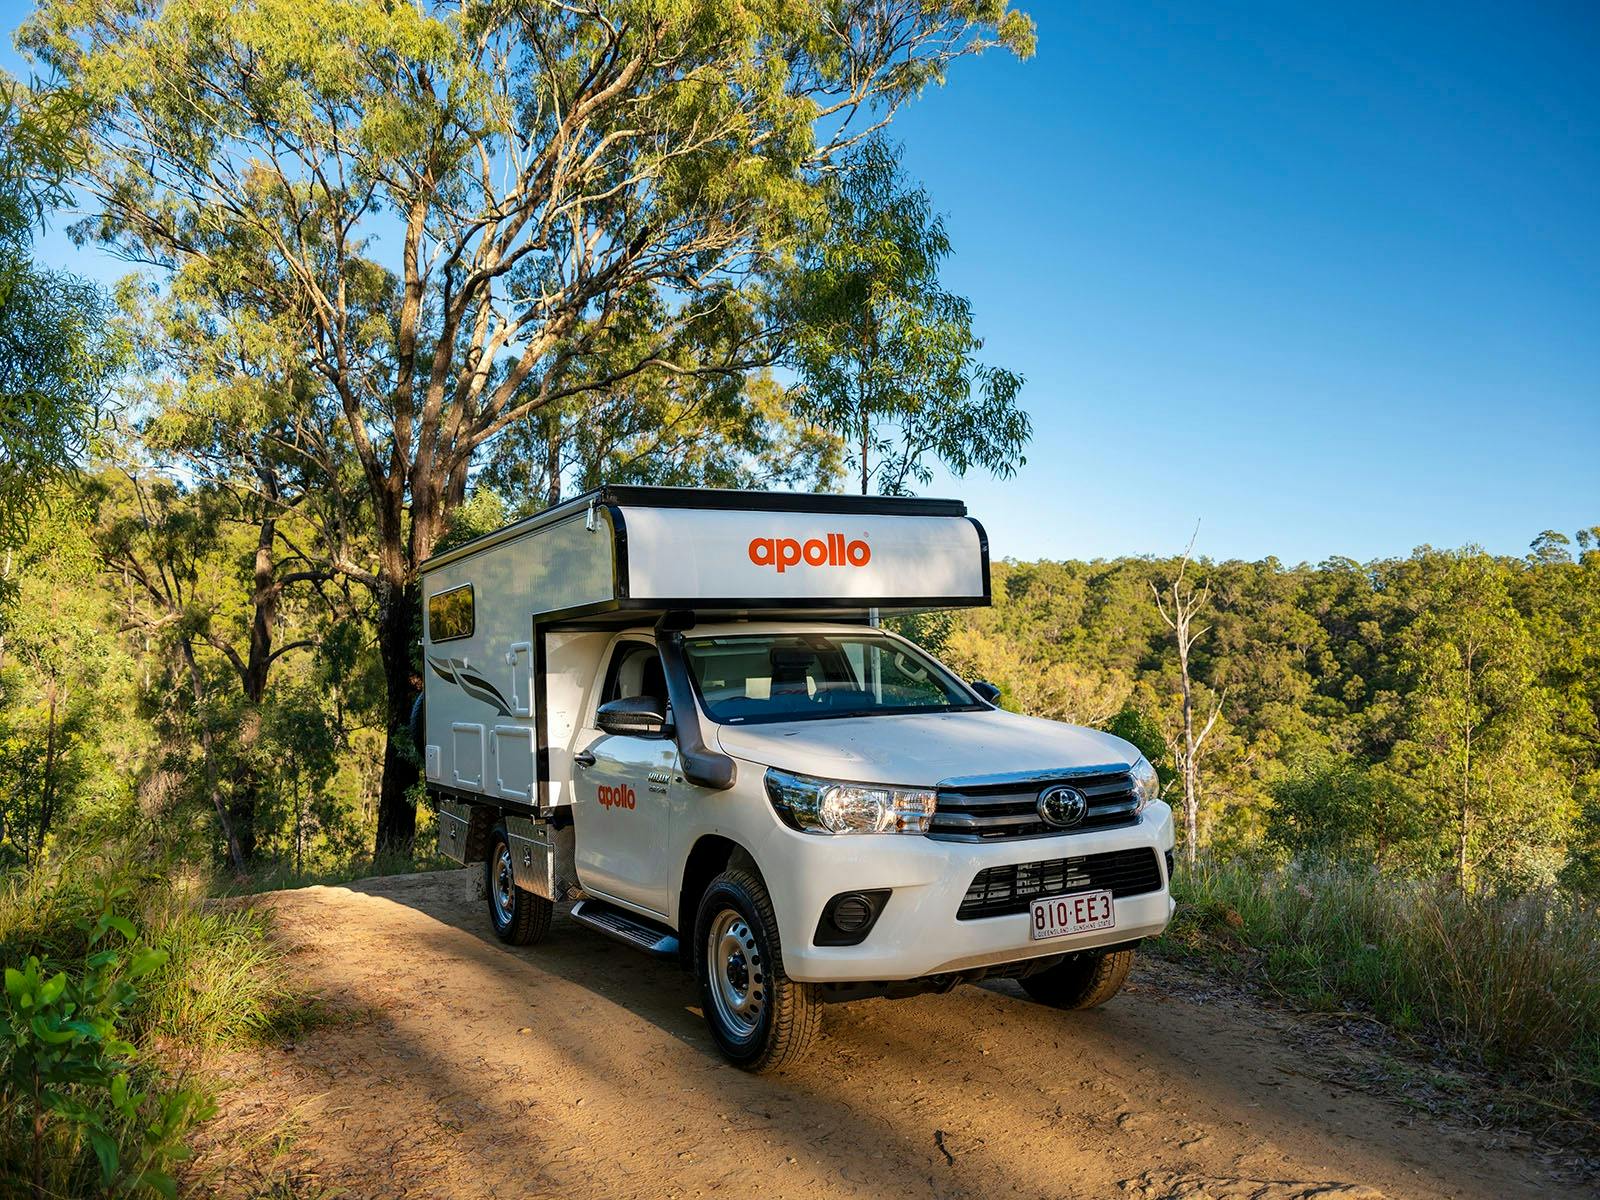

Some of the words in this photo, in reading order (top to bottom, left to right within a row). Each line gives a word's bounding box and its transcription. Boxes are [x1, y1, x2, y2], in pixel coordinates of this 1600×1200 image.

[748, 533, 872, 573] apollo
[598, 783, 635, 810] apollo
[1037, 927, 1069, 938] QUEENSLAND
[1073, 922, 1096, 932] SUNSHINE
[1098, 919, 1111, 928] STATE
